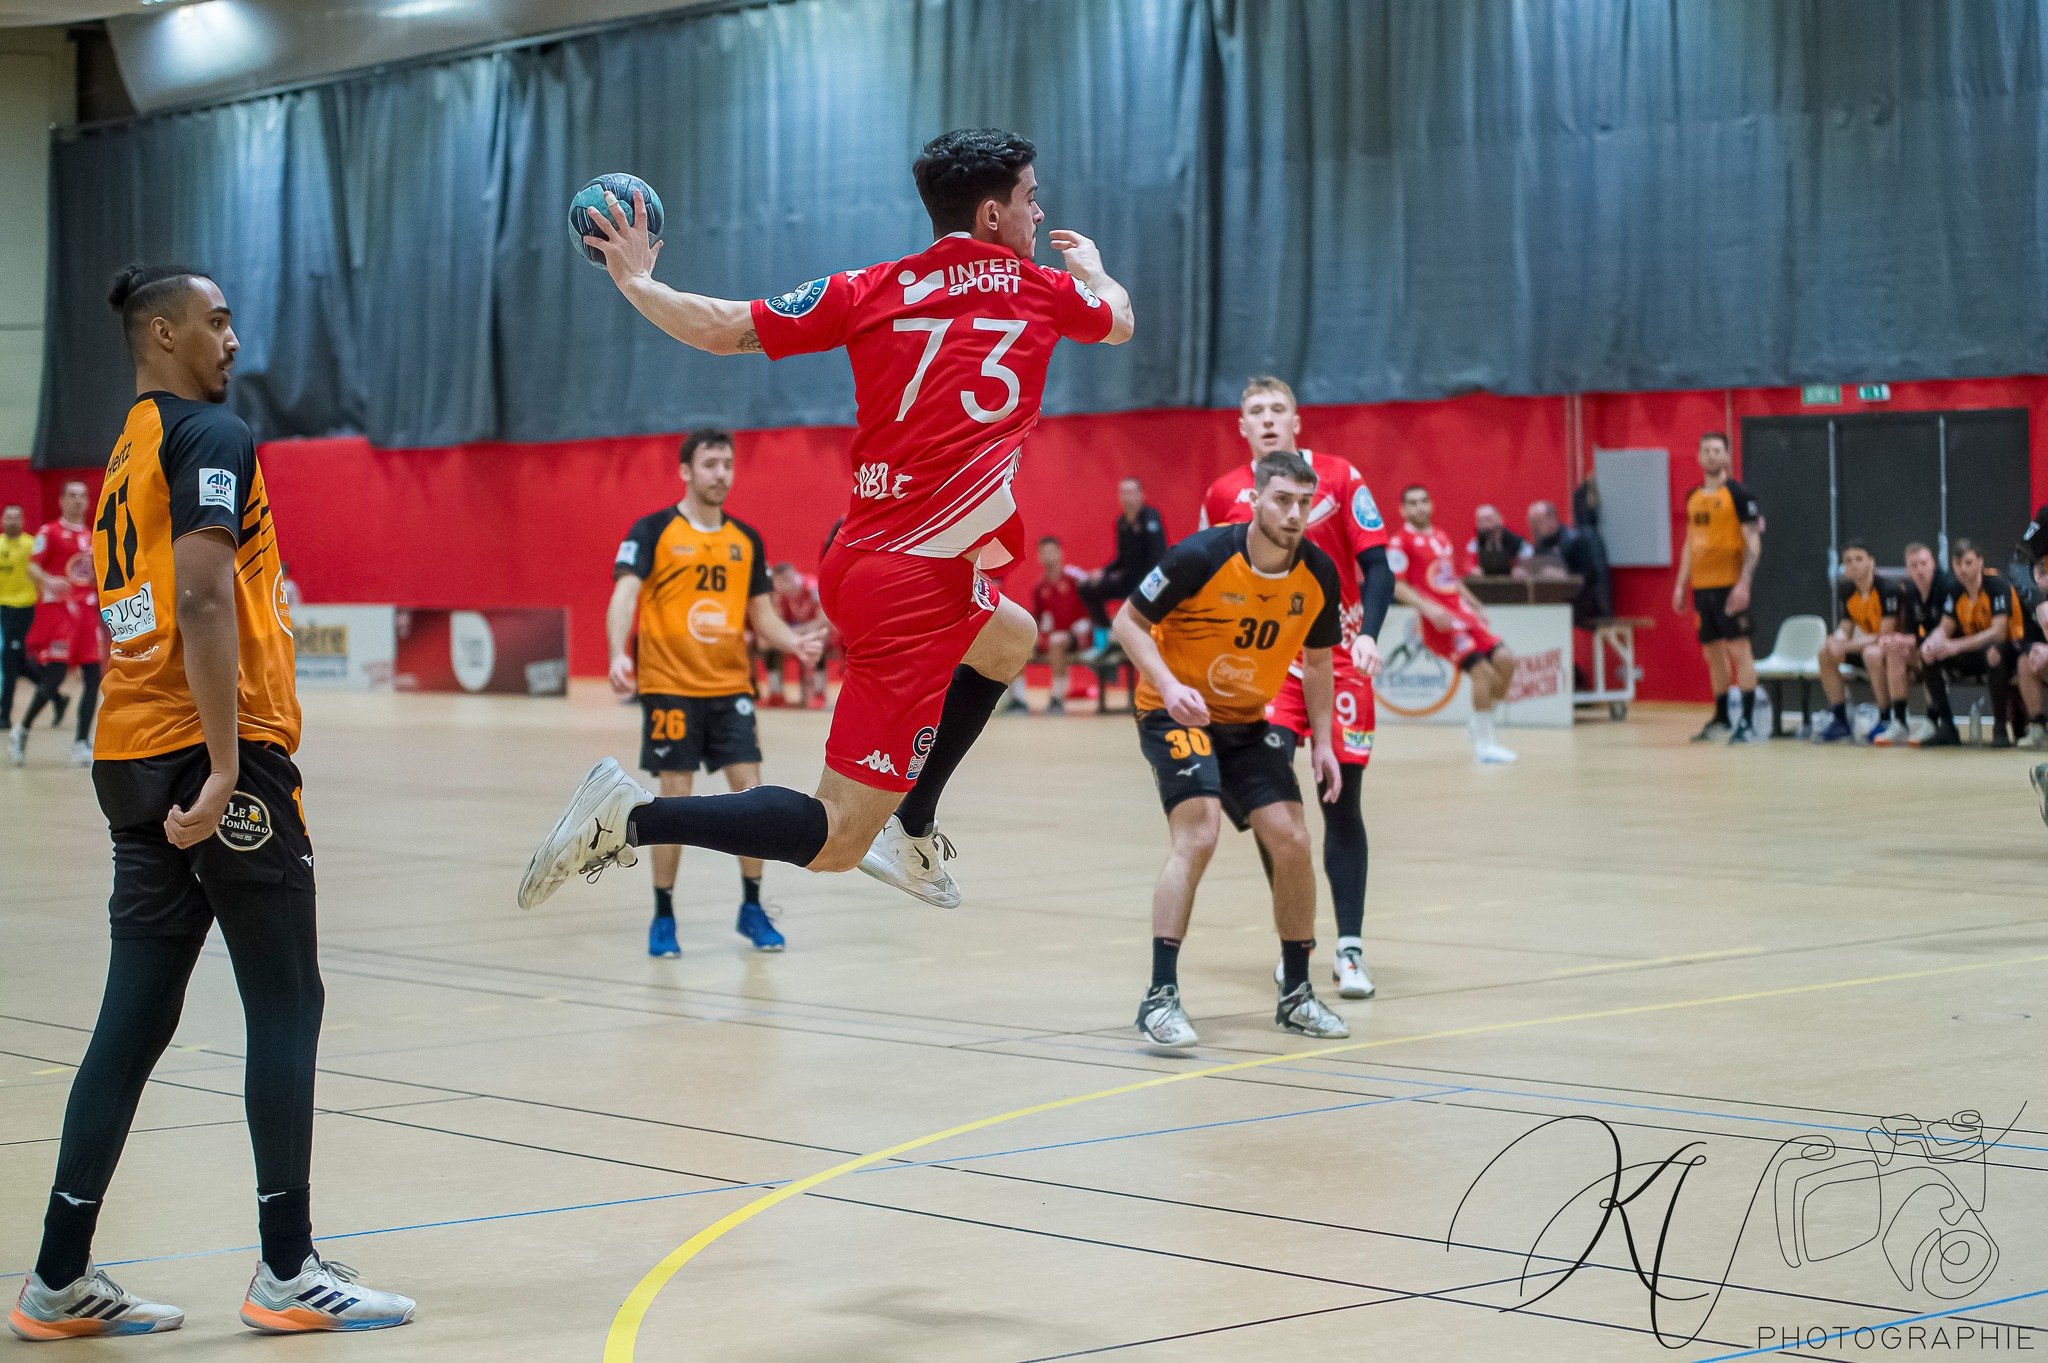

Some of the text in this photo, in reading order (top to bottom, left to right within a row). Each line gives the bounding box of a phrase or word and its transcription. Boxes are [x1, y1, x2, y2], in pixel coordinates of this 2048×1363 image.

[947, 273, 1022, 296] SPORT
[948, 258, 1021, 285] INTER
[770, 296, 799, 313] OBLE
[893, 317, 1028, 424] 73
[695, 564, 726, 592] 26
[1234, 617, 1280, 651] 30
[1336, 691, 1357, 726] 9
[651, 709, 686, 740] 26
[1165, 728, 1211, 760] 30
